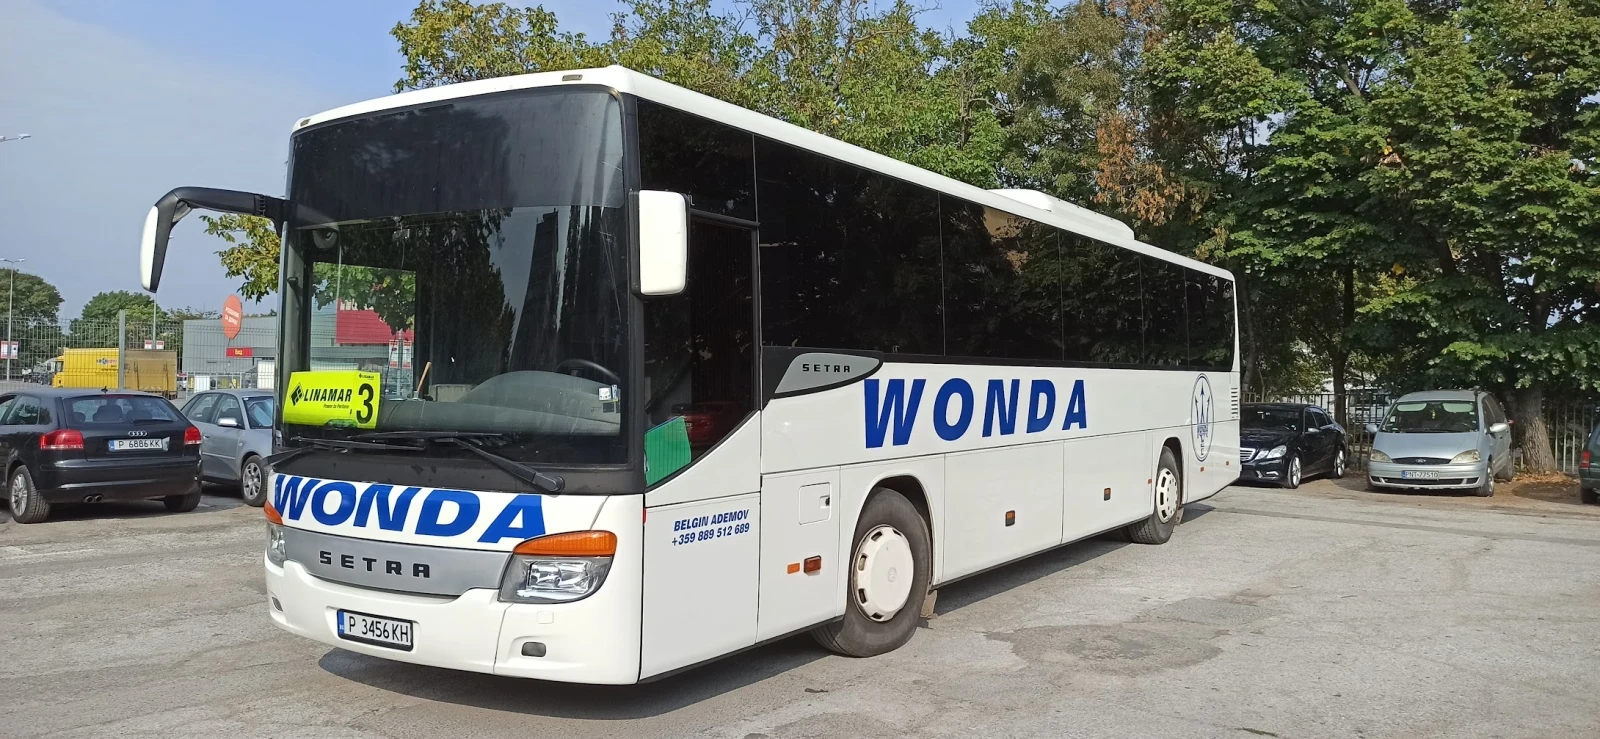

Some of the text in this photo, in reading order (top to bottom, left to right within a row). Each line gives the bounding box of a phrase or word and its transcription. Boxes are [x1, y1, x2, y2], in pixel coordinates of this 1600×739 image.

[802, 363, 850, 373] SETRA
[303, 389, 352, 402] LINAMAR
[356, 383, 374, 424] 3
[864, 377, 1088, 449] WONDA
[118, 440, 125, 449] P
[274, 474, 546, 543] WONDA
[673, 509, 749, 532] BELGIN ADEMOV
[671, 522, 750, 546] +359 889 512 689
[319, 550, 431, 578] SETRA
[349, 616, 356, 633] P
